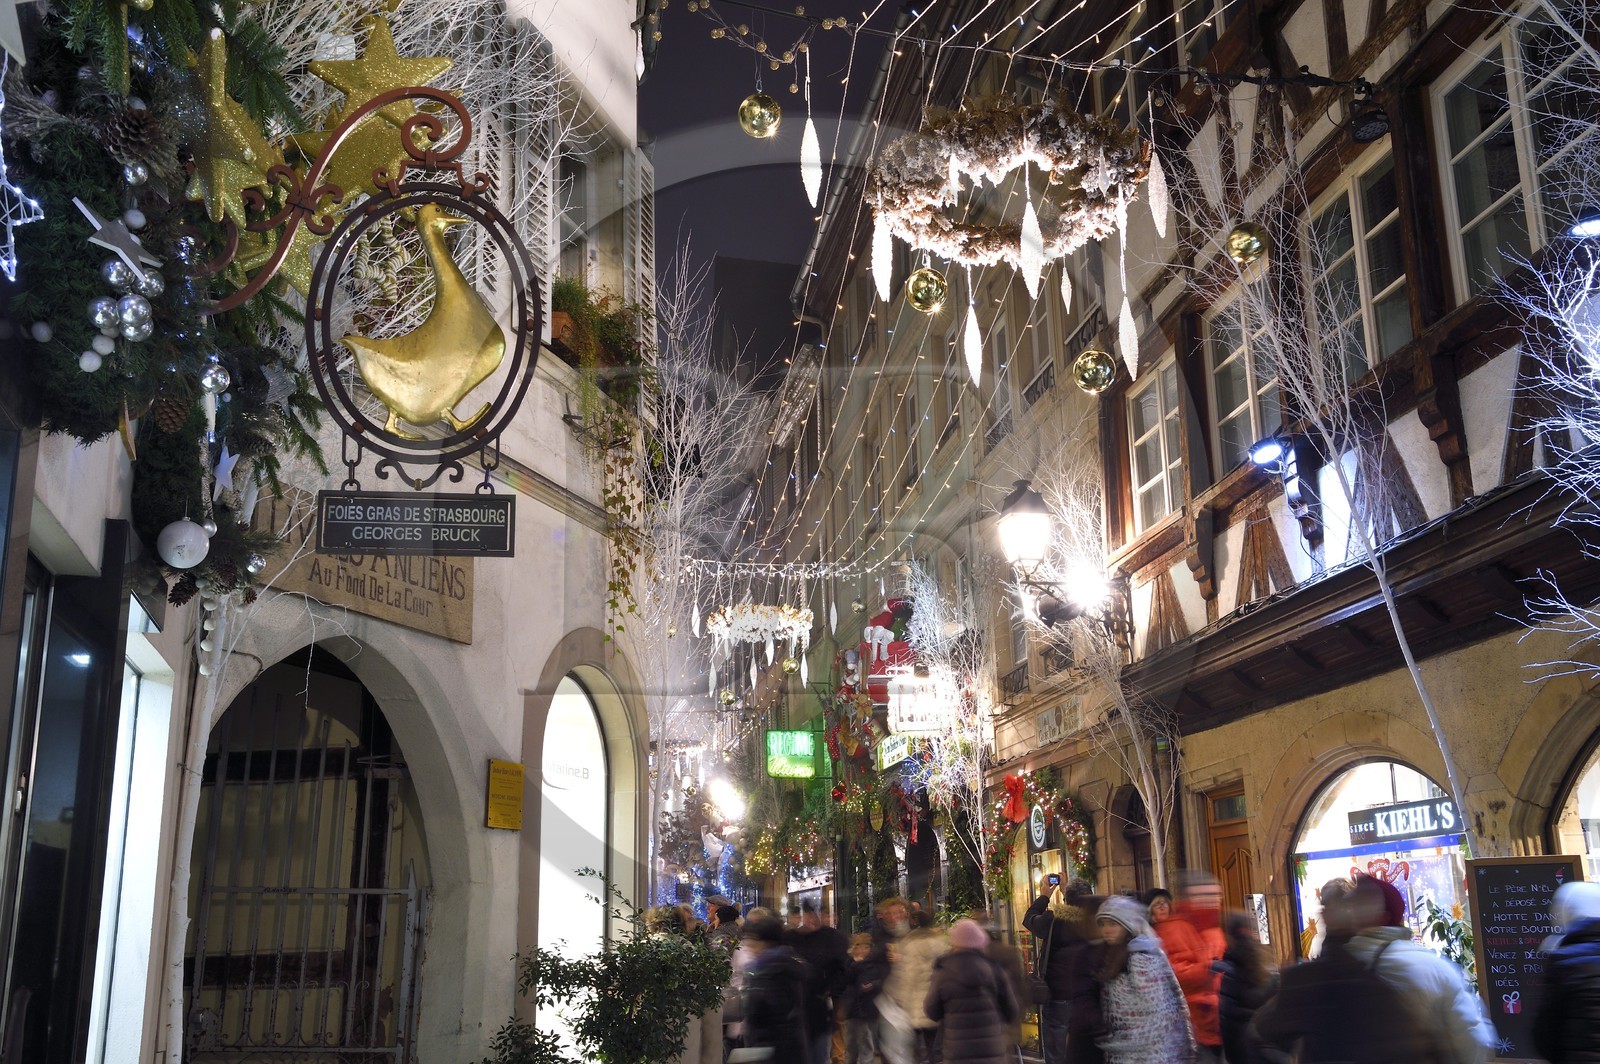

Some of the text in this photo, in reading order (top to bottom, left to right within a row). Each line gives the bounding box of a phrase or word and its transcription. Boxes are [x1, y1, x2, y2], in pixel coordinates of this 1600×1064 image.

[327, 505, 506, 524] FOIES GRAS DE STRASBOURG
[352, 526, 481, 542] GEORGES BRUCK
[307, 557, 434, 618] Au Fond De La Cour
[1349, 801, 1455, 838] SINCE KIEHL'S
[1505, 897, 1537, 907] DÉPOSÉ
[1493, 913, 1528, 922] HOTTE
[1484, 925, 1564, 935] VOTRE BOUTI
[1487, 947, 1517, 960] VENEZ
[1491, 963, 1517, 975] NOS
[1495, 976, 1520, 988] IDÉES
